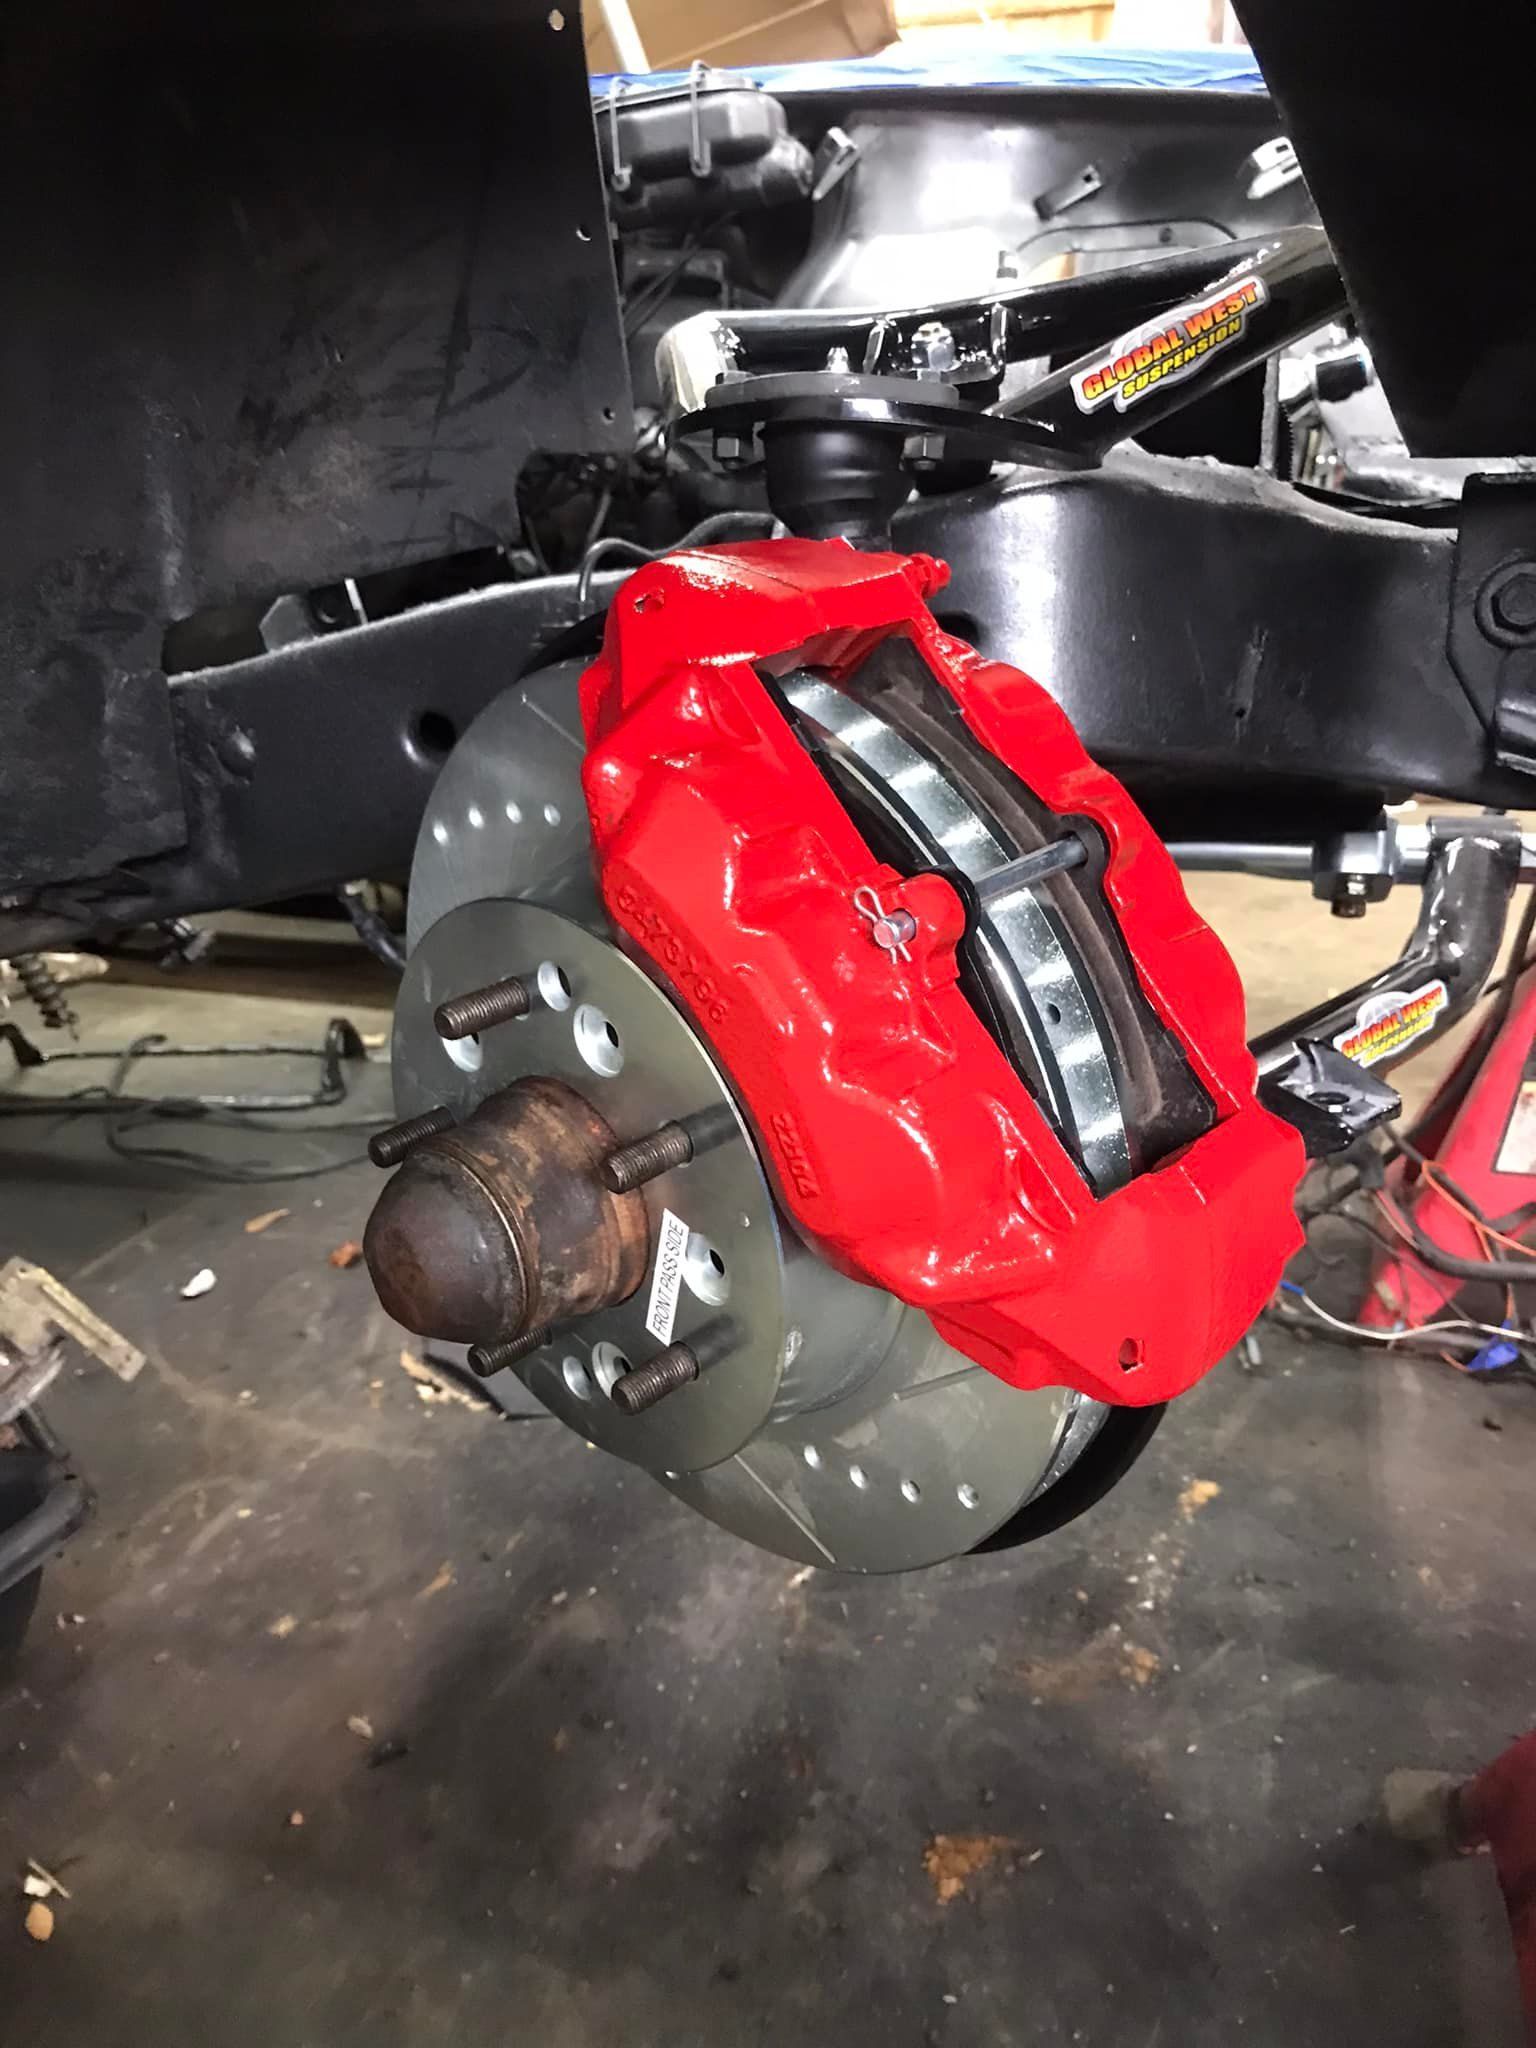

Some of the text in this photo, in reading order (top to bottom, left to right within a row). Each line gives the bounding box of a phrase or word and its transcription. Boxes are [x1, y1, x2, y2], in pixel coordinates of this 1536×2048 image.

[1081, 281, 1257, 400] GLOBAL WEST
[1121, 317, 1242, 400] SUSPENSION
[1341, 1012, 1402, 1059] GLOBAL
[652, 1219, 684, 1338] FRONT PASS SIDE
